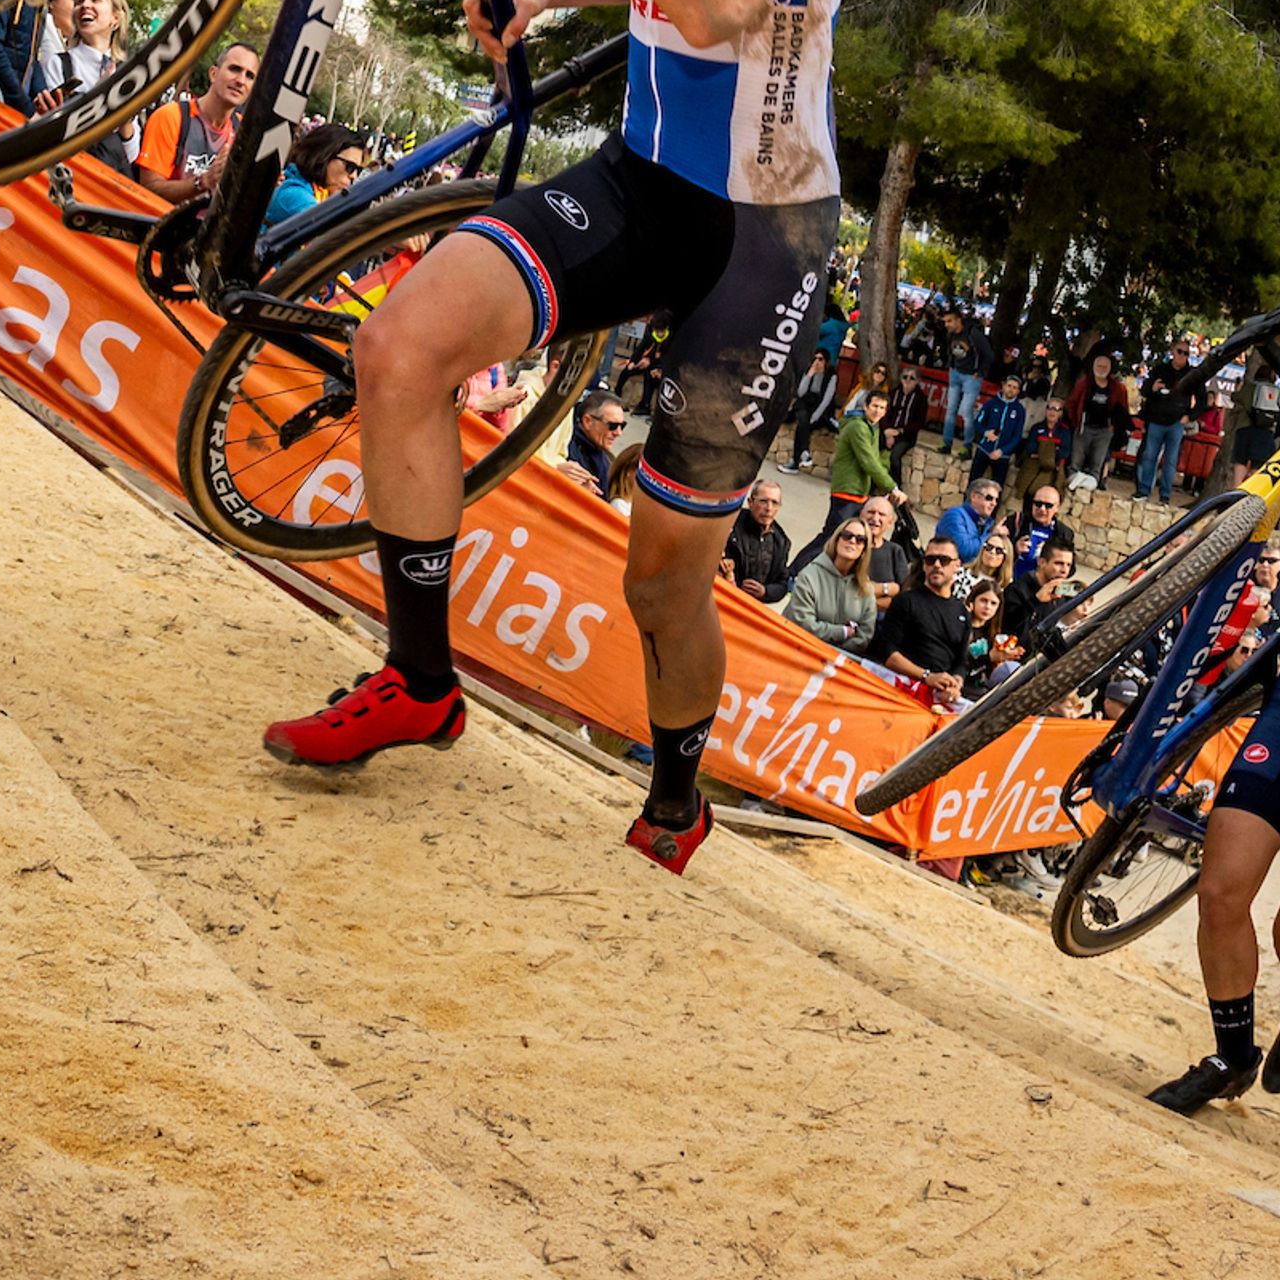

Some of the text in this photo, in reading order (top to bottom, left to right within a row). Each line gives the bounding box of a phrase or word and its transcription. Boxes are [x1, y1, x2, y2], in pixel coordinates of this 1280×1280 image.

[769, 11, 787, 78] SALLES
[780, 12, 805, 125] BADKAMERS
[764, 82, 779, 106] DE
[757, 114, 776, 166] BAINS
[741, 272, 819, 400] baloise
[210, 336, 264, 528] ONTRAGER
